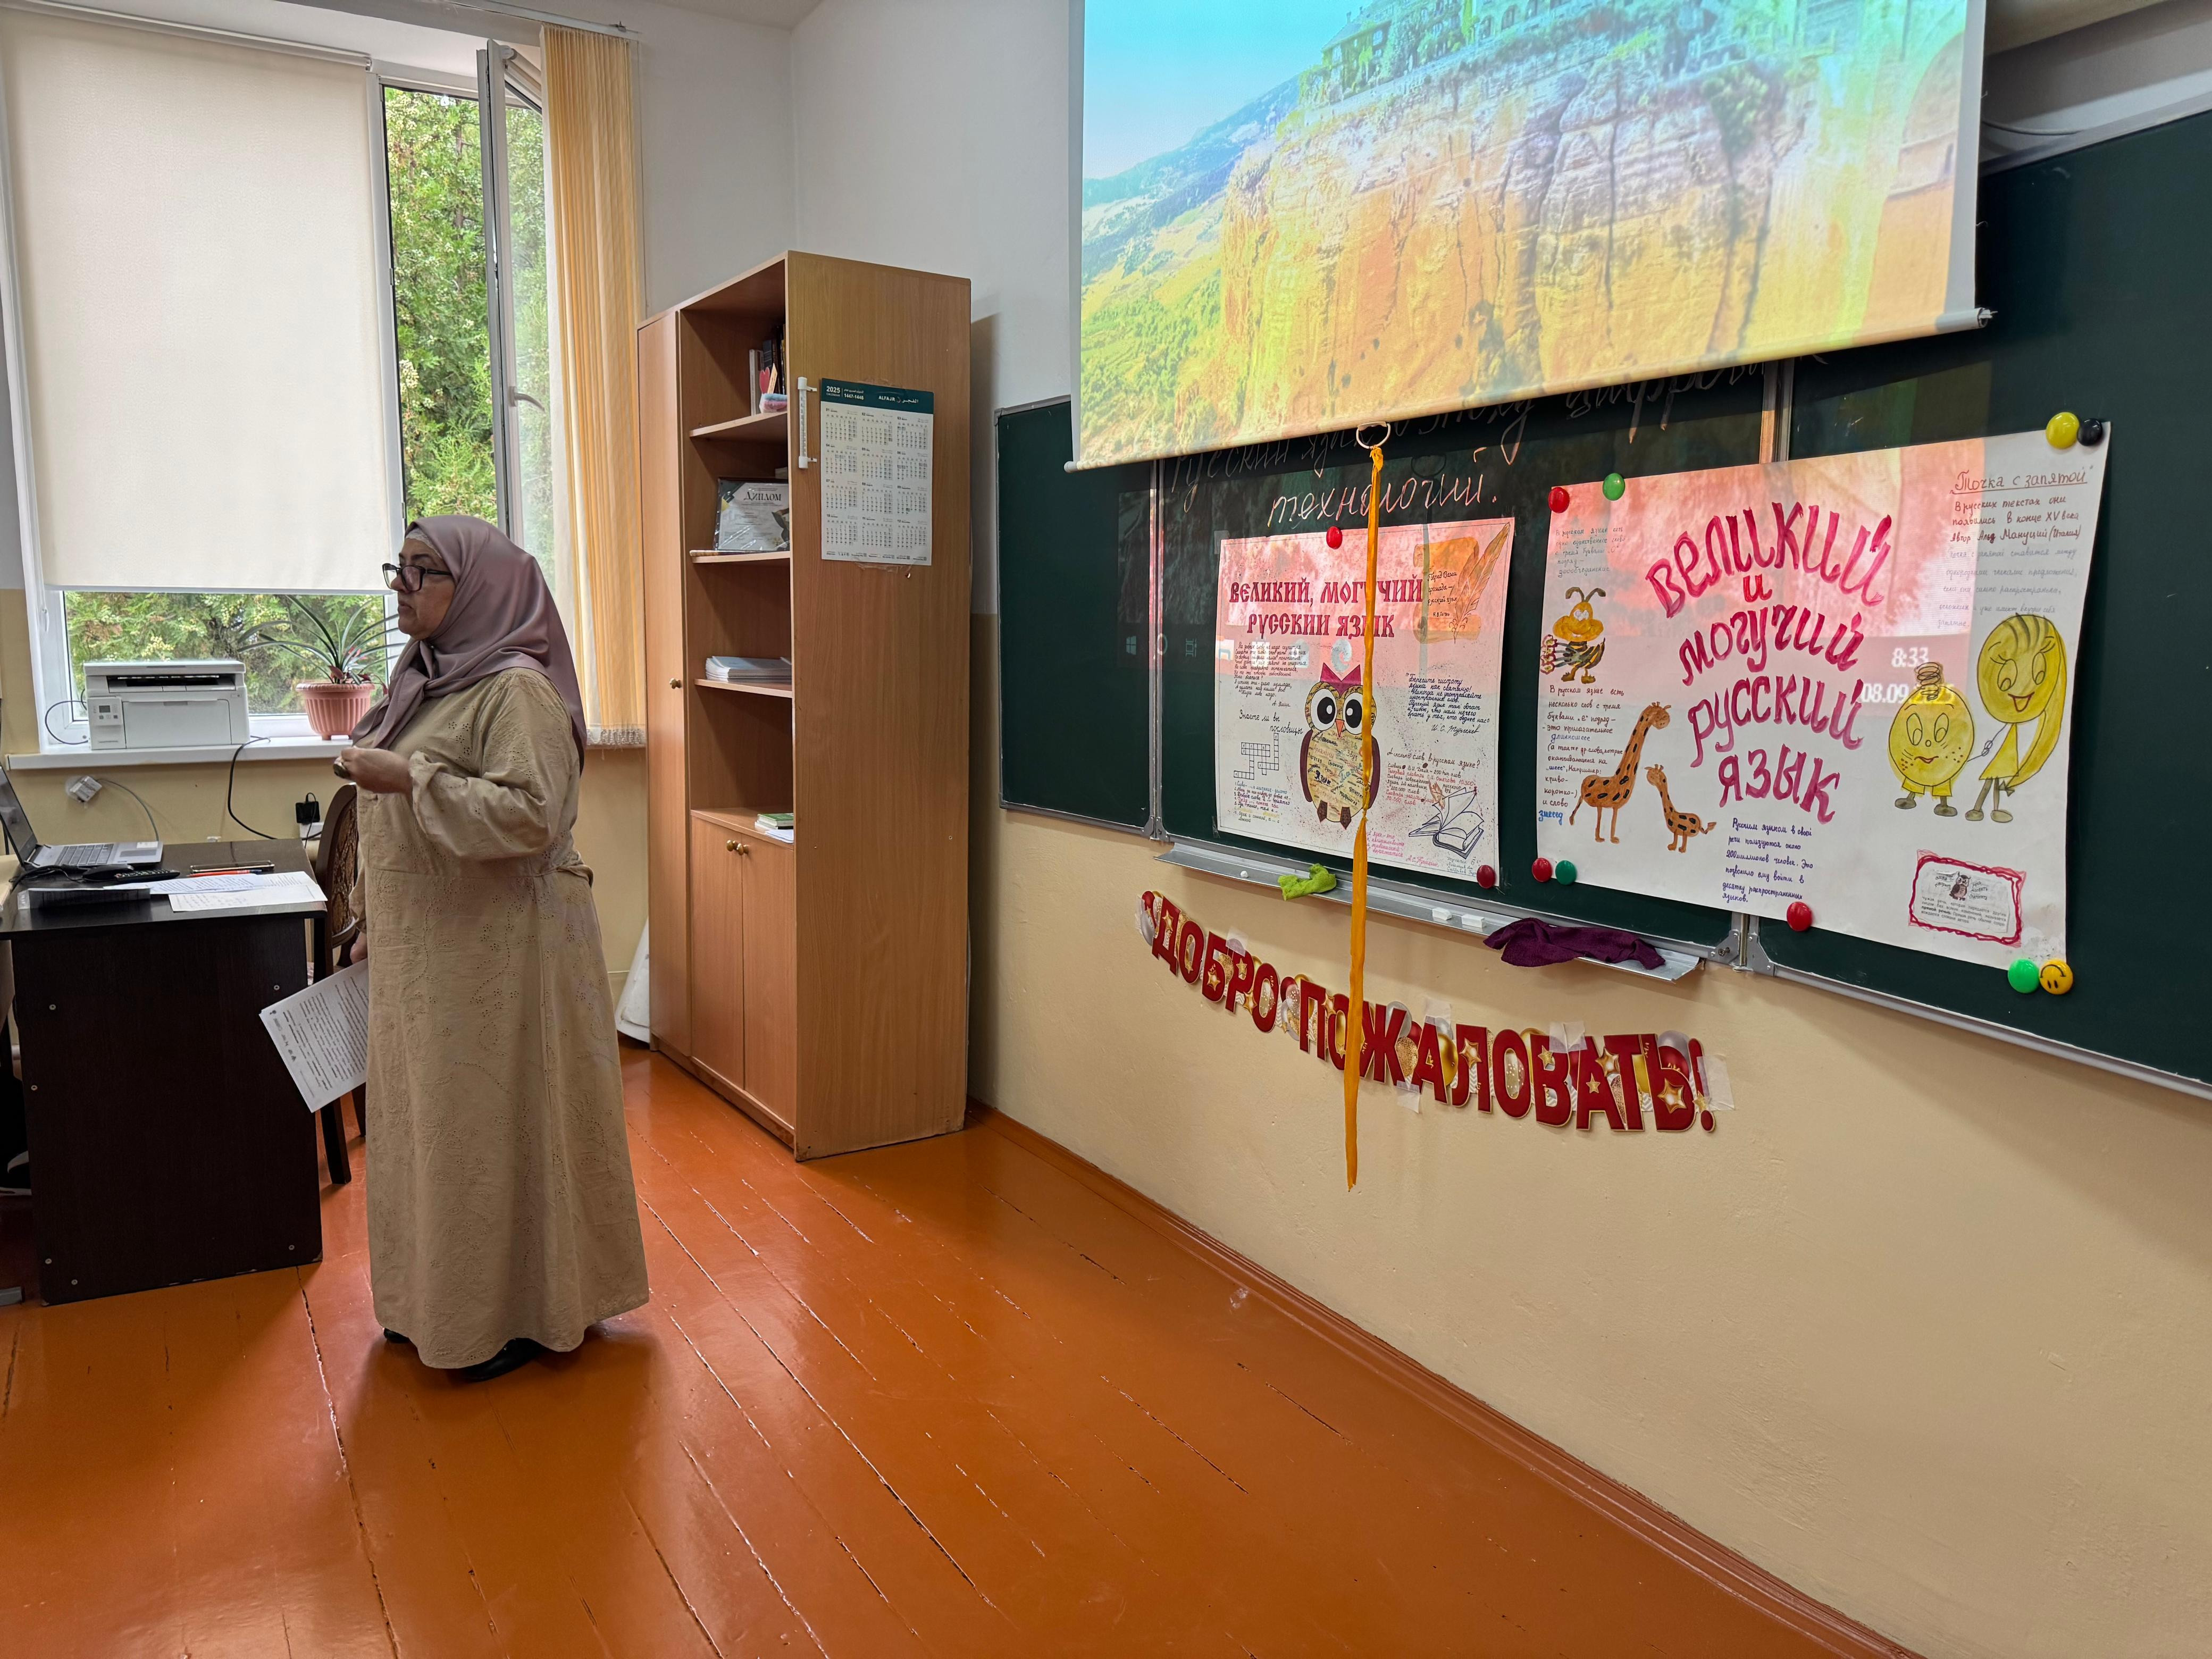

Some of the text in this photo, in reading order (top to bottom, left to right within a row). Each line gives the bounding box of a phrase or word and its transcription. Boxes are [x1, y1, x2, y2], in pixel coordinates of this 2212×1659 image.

[2013, 476, 2021, 485] с
[2049, 496, 2067, 505] они
[2062, 511, 2079, 520] века
[1320, 574, 1423, 604] МОГЧИЙ
[1438, 678, 1463, 687] чистоту
[1558, 688, 1581, 696] русском
[1581, 699, 1593, 708] слов
[1239, 709, 1260, 720] Знаете
[1547, 711, 1574, 722] буквами
[1590, 717, 1610, 727] подряд
[1270, 722, 1303, 735] пословицы
[1564, 725, 1613, 734] прилагательное
[1412, 752, 1425, 761] слов
[1549, 798, 1569, 807] слово
[1732, 817, 1812, 836] Русским языком в своей
[1728, 836, 1740, 845] речи
[1774, 856, 1799, 867] человек.
[1802, 859, 1813, 869] Это
[1725, 865, 1804, 884] позволило ему войти в
[1722, 882, 1745, 894] десятку
[1722, 893, 1748, 903] языков.
[1151, 896, 1716, 1133] ДОБРО ПОЖАЛОВАТЬ!
